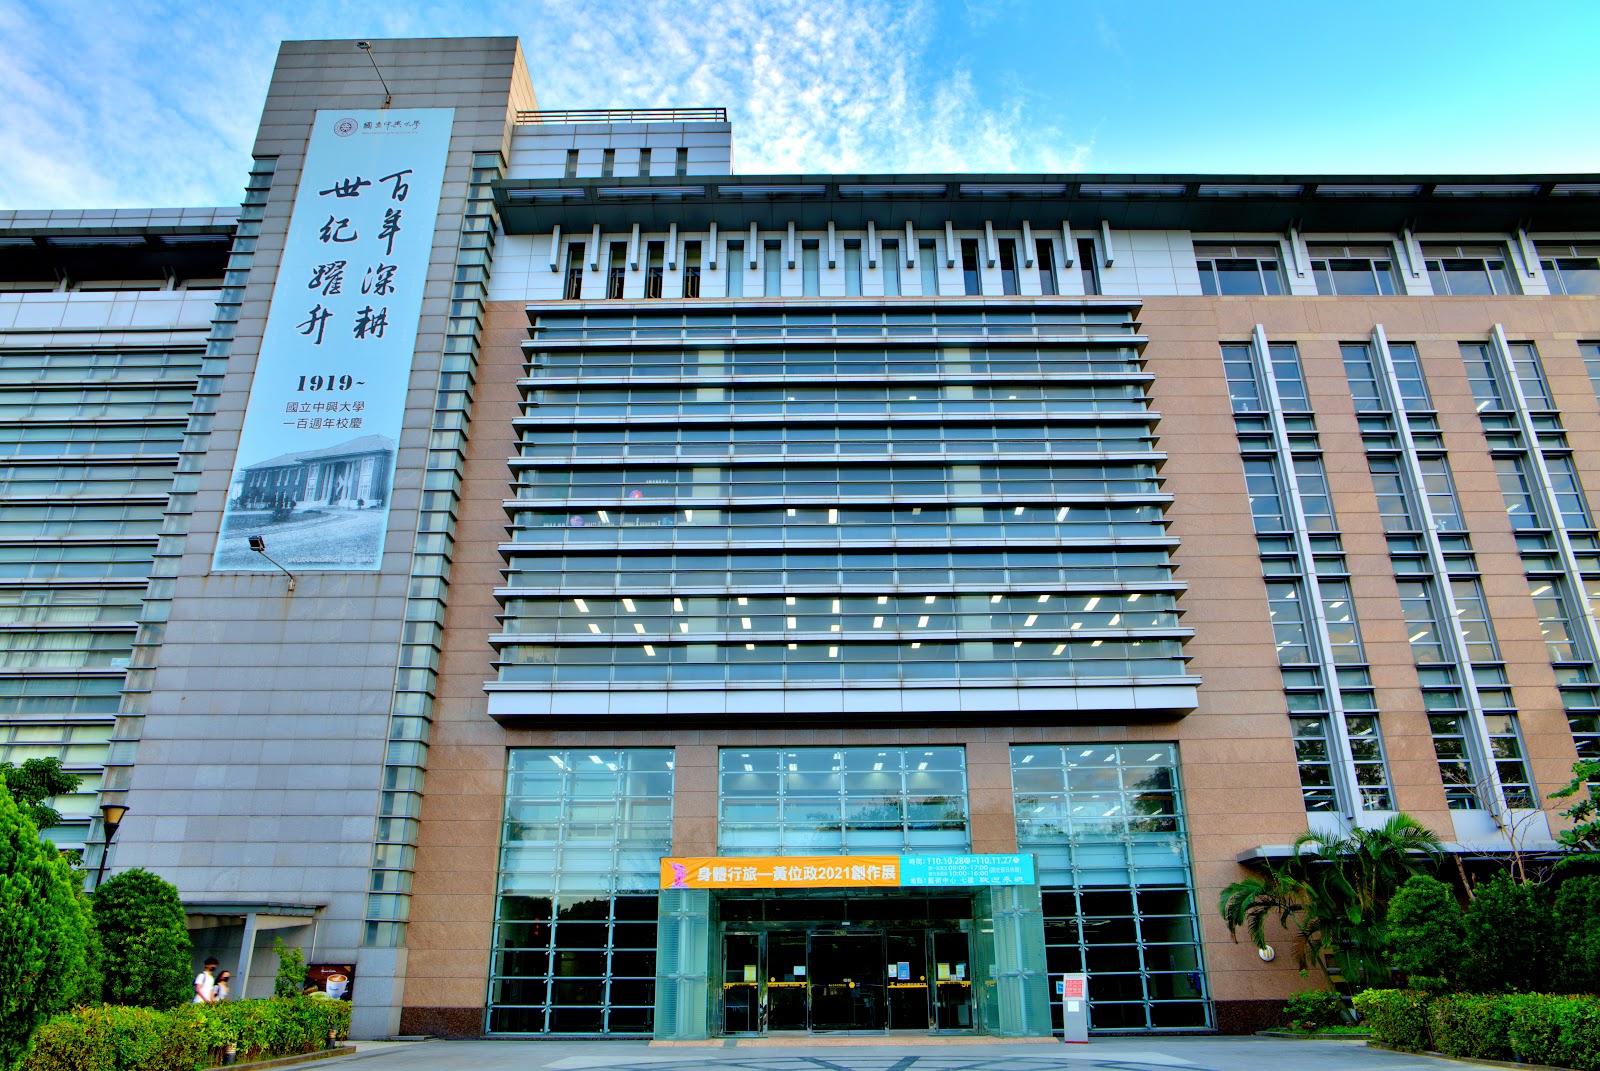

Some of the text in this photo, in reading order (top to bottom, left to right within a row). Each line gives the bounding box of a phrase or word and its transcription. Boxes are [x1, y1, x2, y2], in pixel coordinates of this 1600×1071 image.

[285, 401, 365, 413] 國立中興大學
[283, 417, 363, 430] 一百週年校慶
